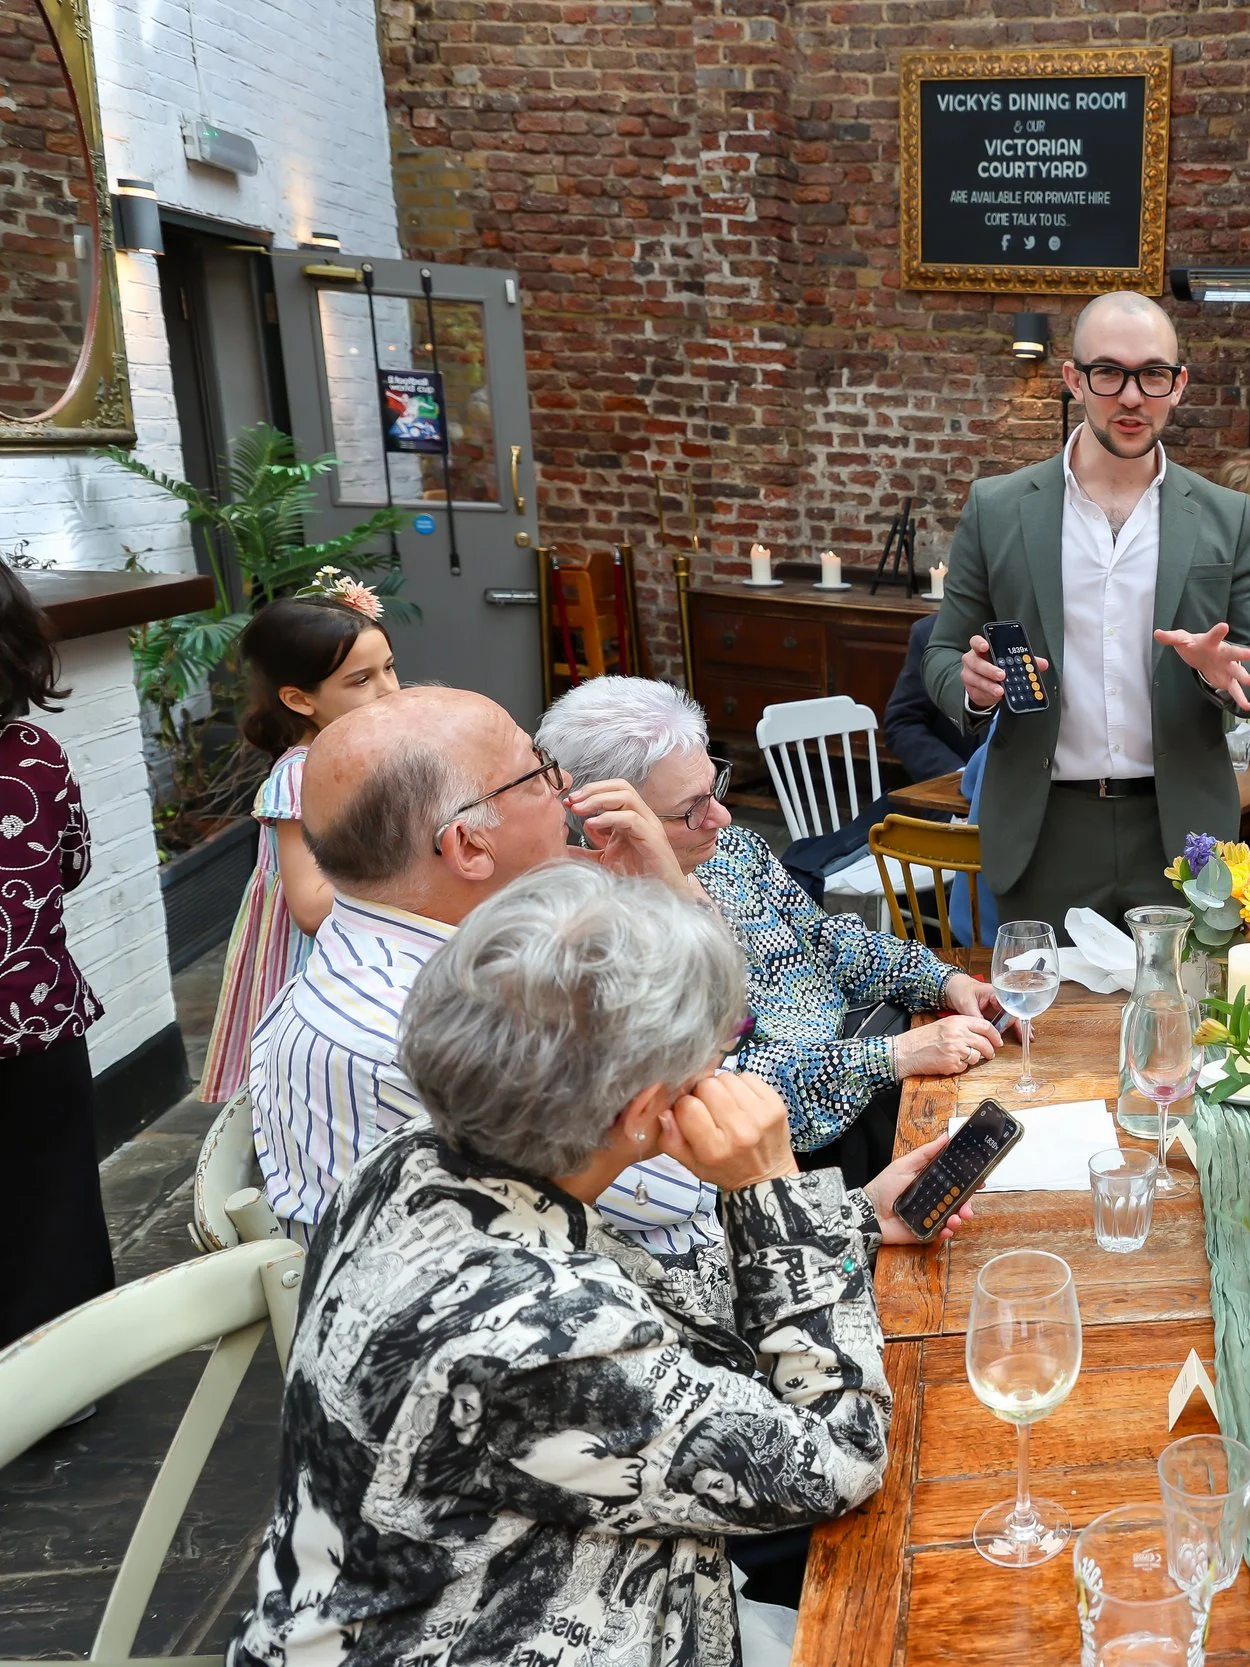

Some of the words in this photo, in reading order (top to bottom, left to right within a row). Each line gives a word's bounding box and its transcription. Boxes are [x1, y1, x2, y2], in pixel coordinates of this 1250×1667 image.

[937, 92, 1002, 112] VICKY'S
[1009, 93, 1070, 111] DINING
[1076, 92, 1126, 110] ROOM
[1014, 121, 1022, 133] &
[1026, 120, 1045, 132] OUR
[985, 138, 1081, 156] VICTORIAN
[978, 161, 1087, 178] COURTYARD
[950, 191, 967, 203] ARE
[971, 191, 1021, 204] AVAILABLE
[1024, 191, 1043, 203] FOR
[1045, 191, 1086, 204] PRIVATE
[1088, 191, 1110, 204] HIRE
[985, 213, 1009, 225] COME
[1012, 213, 1037, 225] TALK
[1039, 213, 1052, 226] TO
